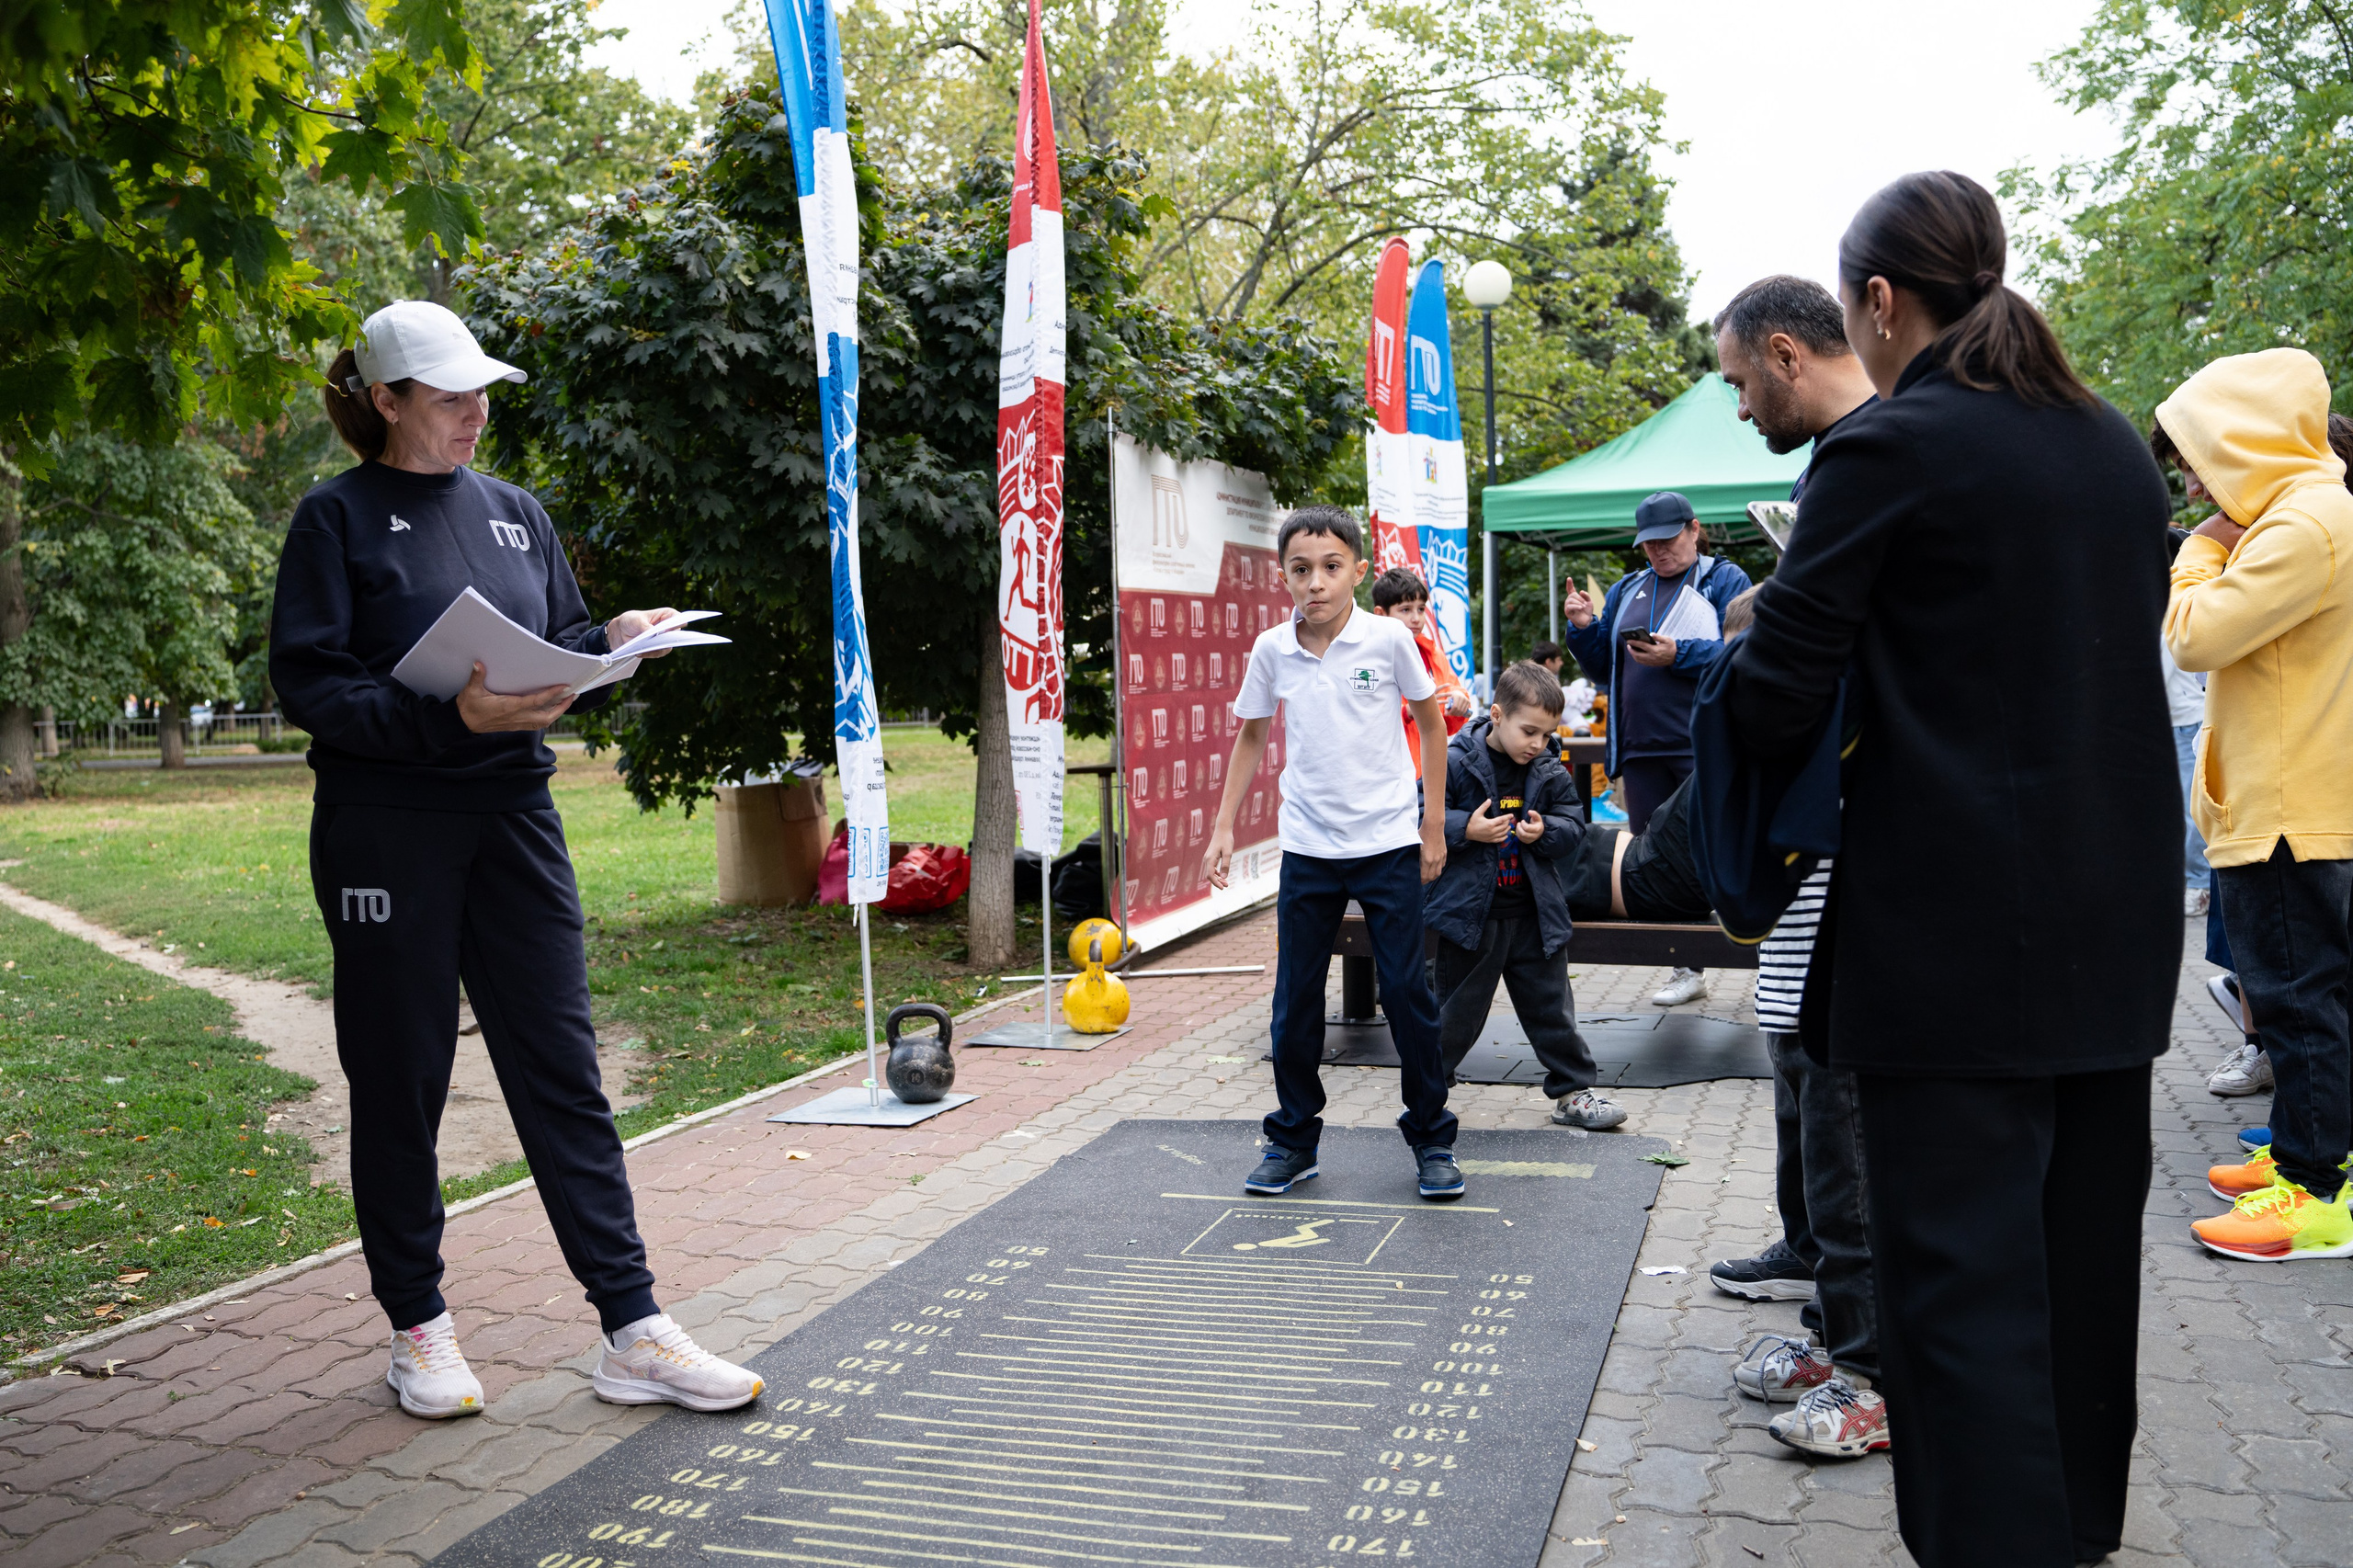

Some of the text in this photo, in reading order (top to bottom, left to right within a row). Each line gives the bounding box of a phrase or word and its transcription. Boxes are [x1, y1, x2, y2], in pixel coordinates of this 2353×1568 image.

[488, 519, 530, 551] ГТО
[341, 887, 392, 923] ГТО
[891, 1322, 952, 1337] 100
[864, 1339, 928, 1356] 110
[835, 1357, 904, 1375] 120
[1433, 1360, 1501, 1376] 100
[807, 1376, 878, 1395] 130
[1420, 1381, 1493, 1396] 110
[776, 1398, 846, 1417] 140
[1408, 1403, 1481, 1420] 120
[742, 1421, 815, 1442] 150
[1392, 1426, 1470, 1443] 130
[707, 1444, 782, 1466] 160
[1379, 1450, 1458, 1470] 140
[669, 1468, 749, 1492] 170
[1361, 1477, 1445, 1497] 150
[630, 1494, 711, 1519] 180
[1345, 1505, 1430, 1527] 160
[587, 1522, 675, 1549] 190
[1327, 1534, 1415, 1557] 170
